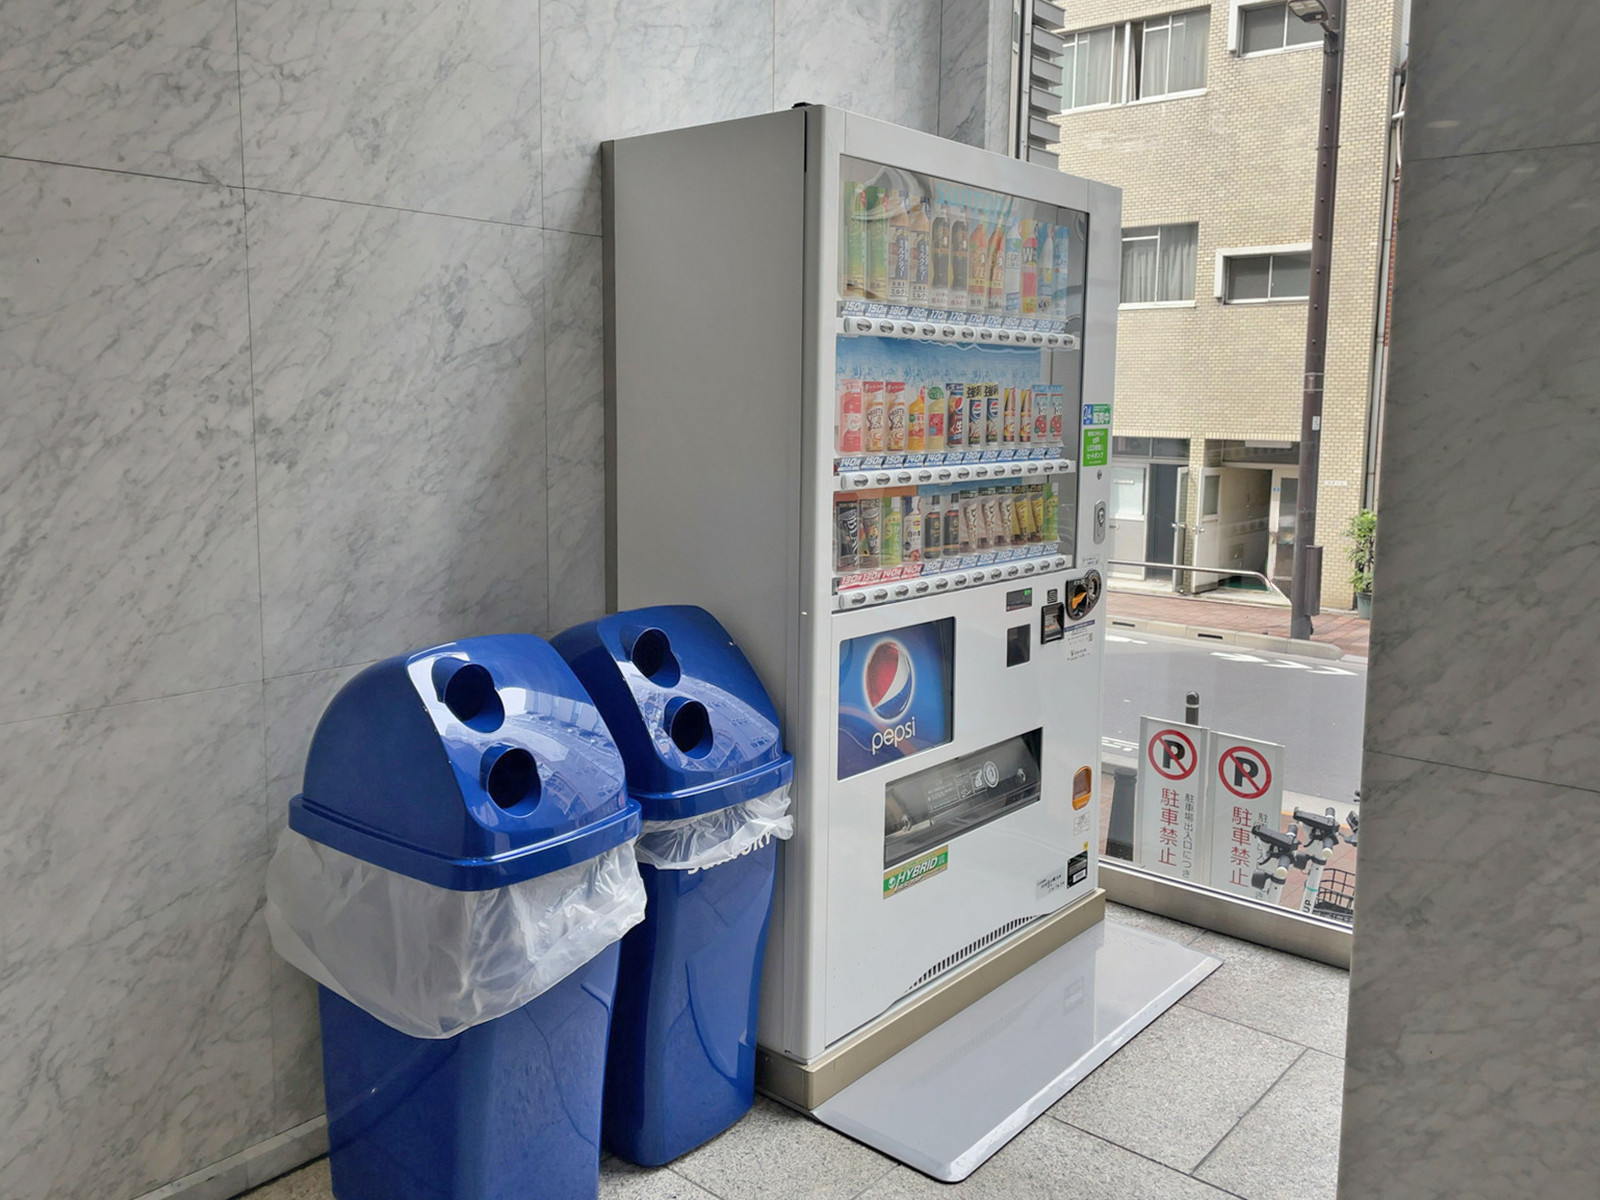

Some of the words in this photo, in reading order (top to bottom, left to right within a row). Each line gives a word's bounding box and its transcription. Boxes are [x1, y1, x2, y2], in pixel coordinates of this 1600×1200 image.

[871, 716, 916, 755] pepsi
[1158, 787, 1181, 868] 駐車禁止
[1230, 805, 1253, 888] 駐車禁止
[895, 856, 938, 892] HYBRID
